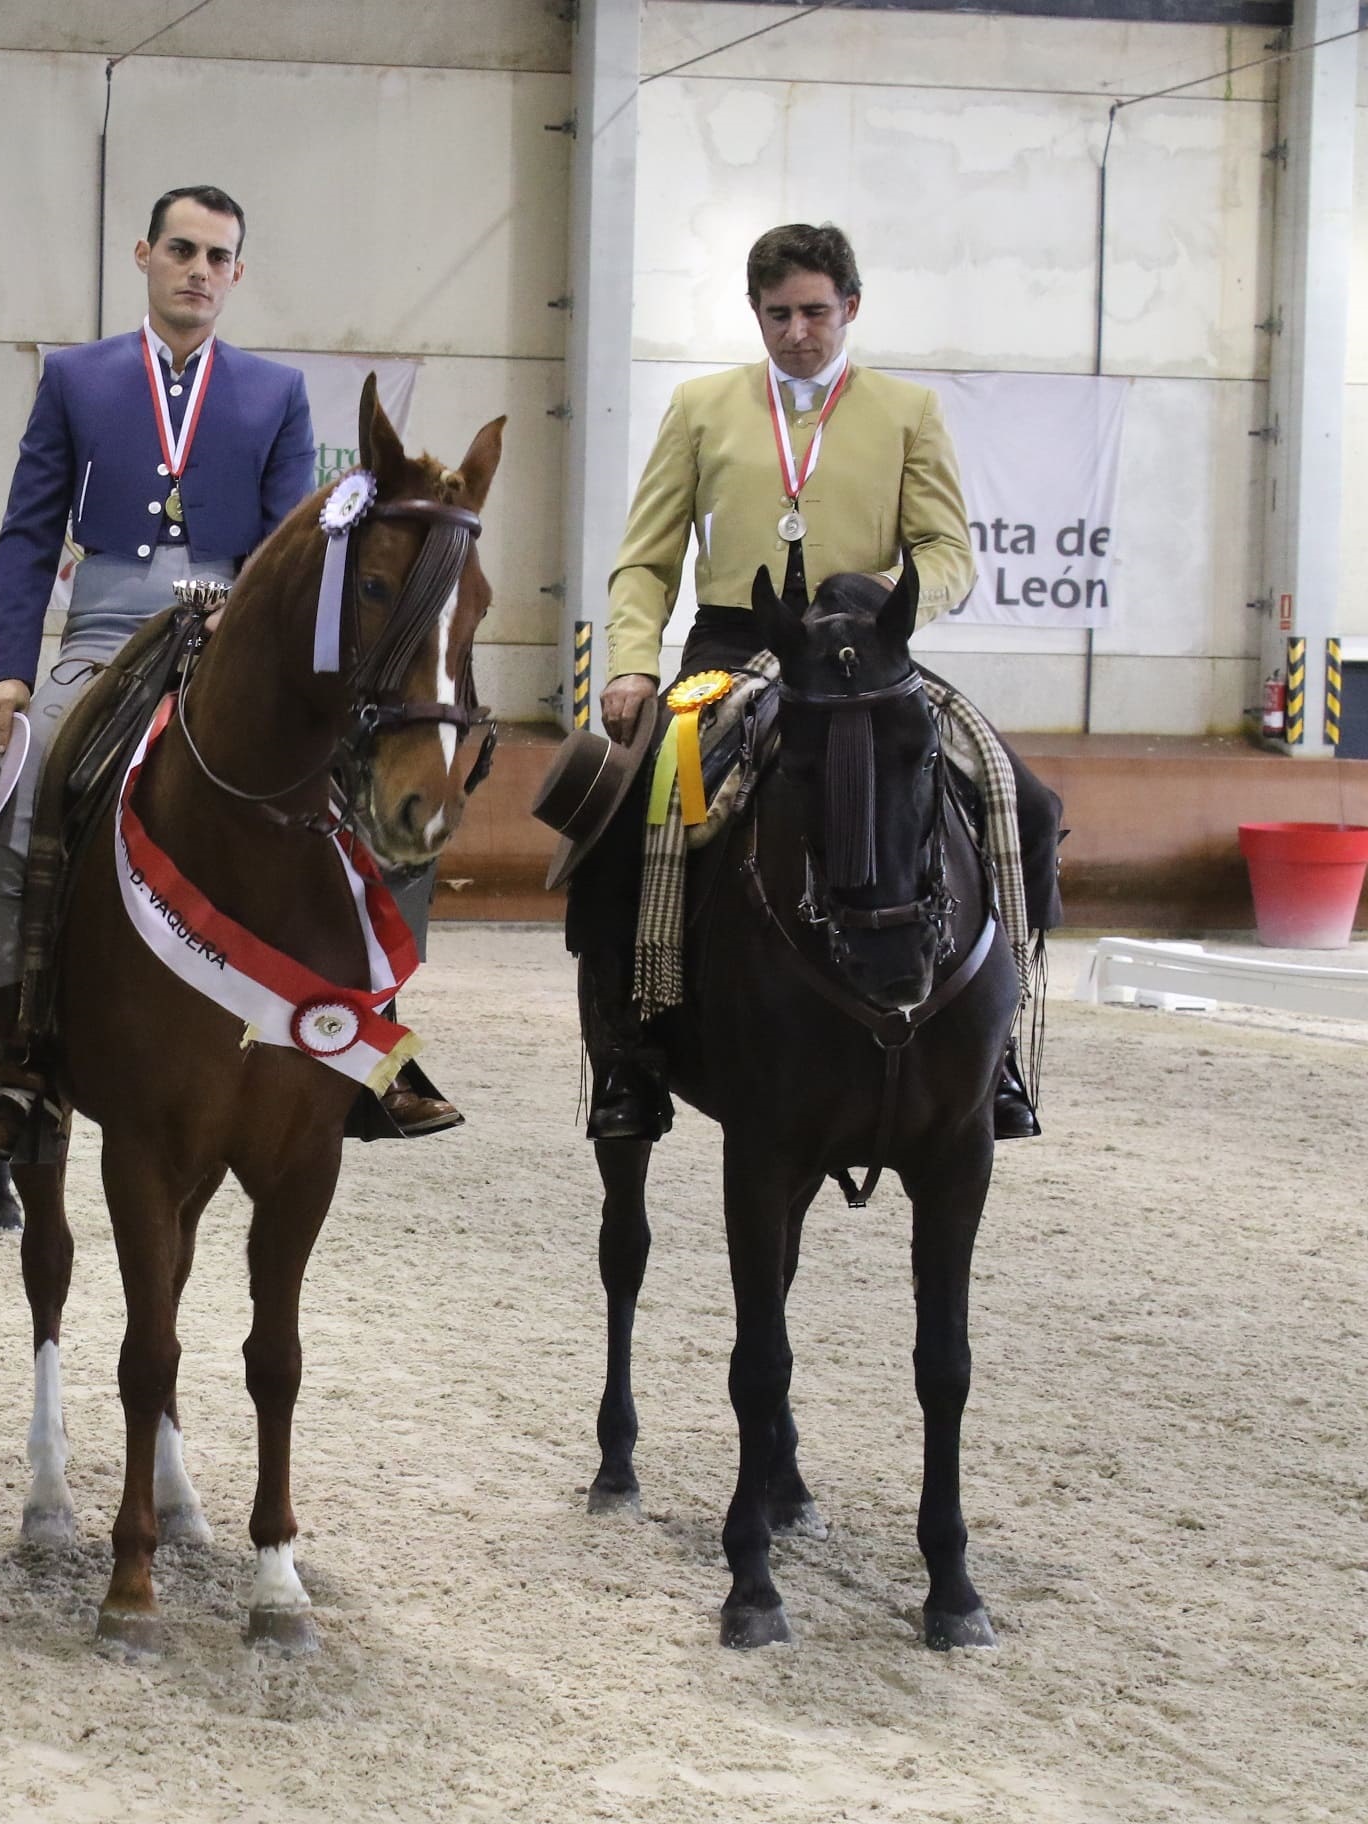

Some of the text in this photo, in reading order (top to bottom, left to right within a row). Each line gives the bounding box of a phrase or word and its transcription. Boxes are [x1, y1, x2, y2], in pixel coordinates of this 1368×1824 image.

[969, 518, 1111, 557] nta de
[995, 565, 1109, 608] León
[149, 887, 228, 970] VAQUERA
